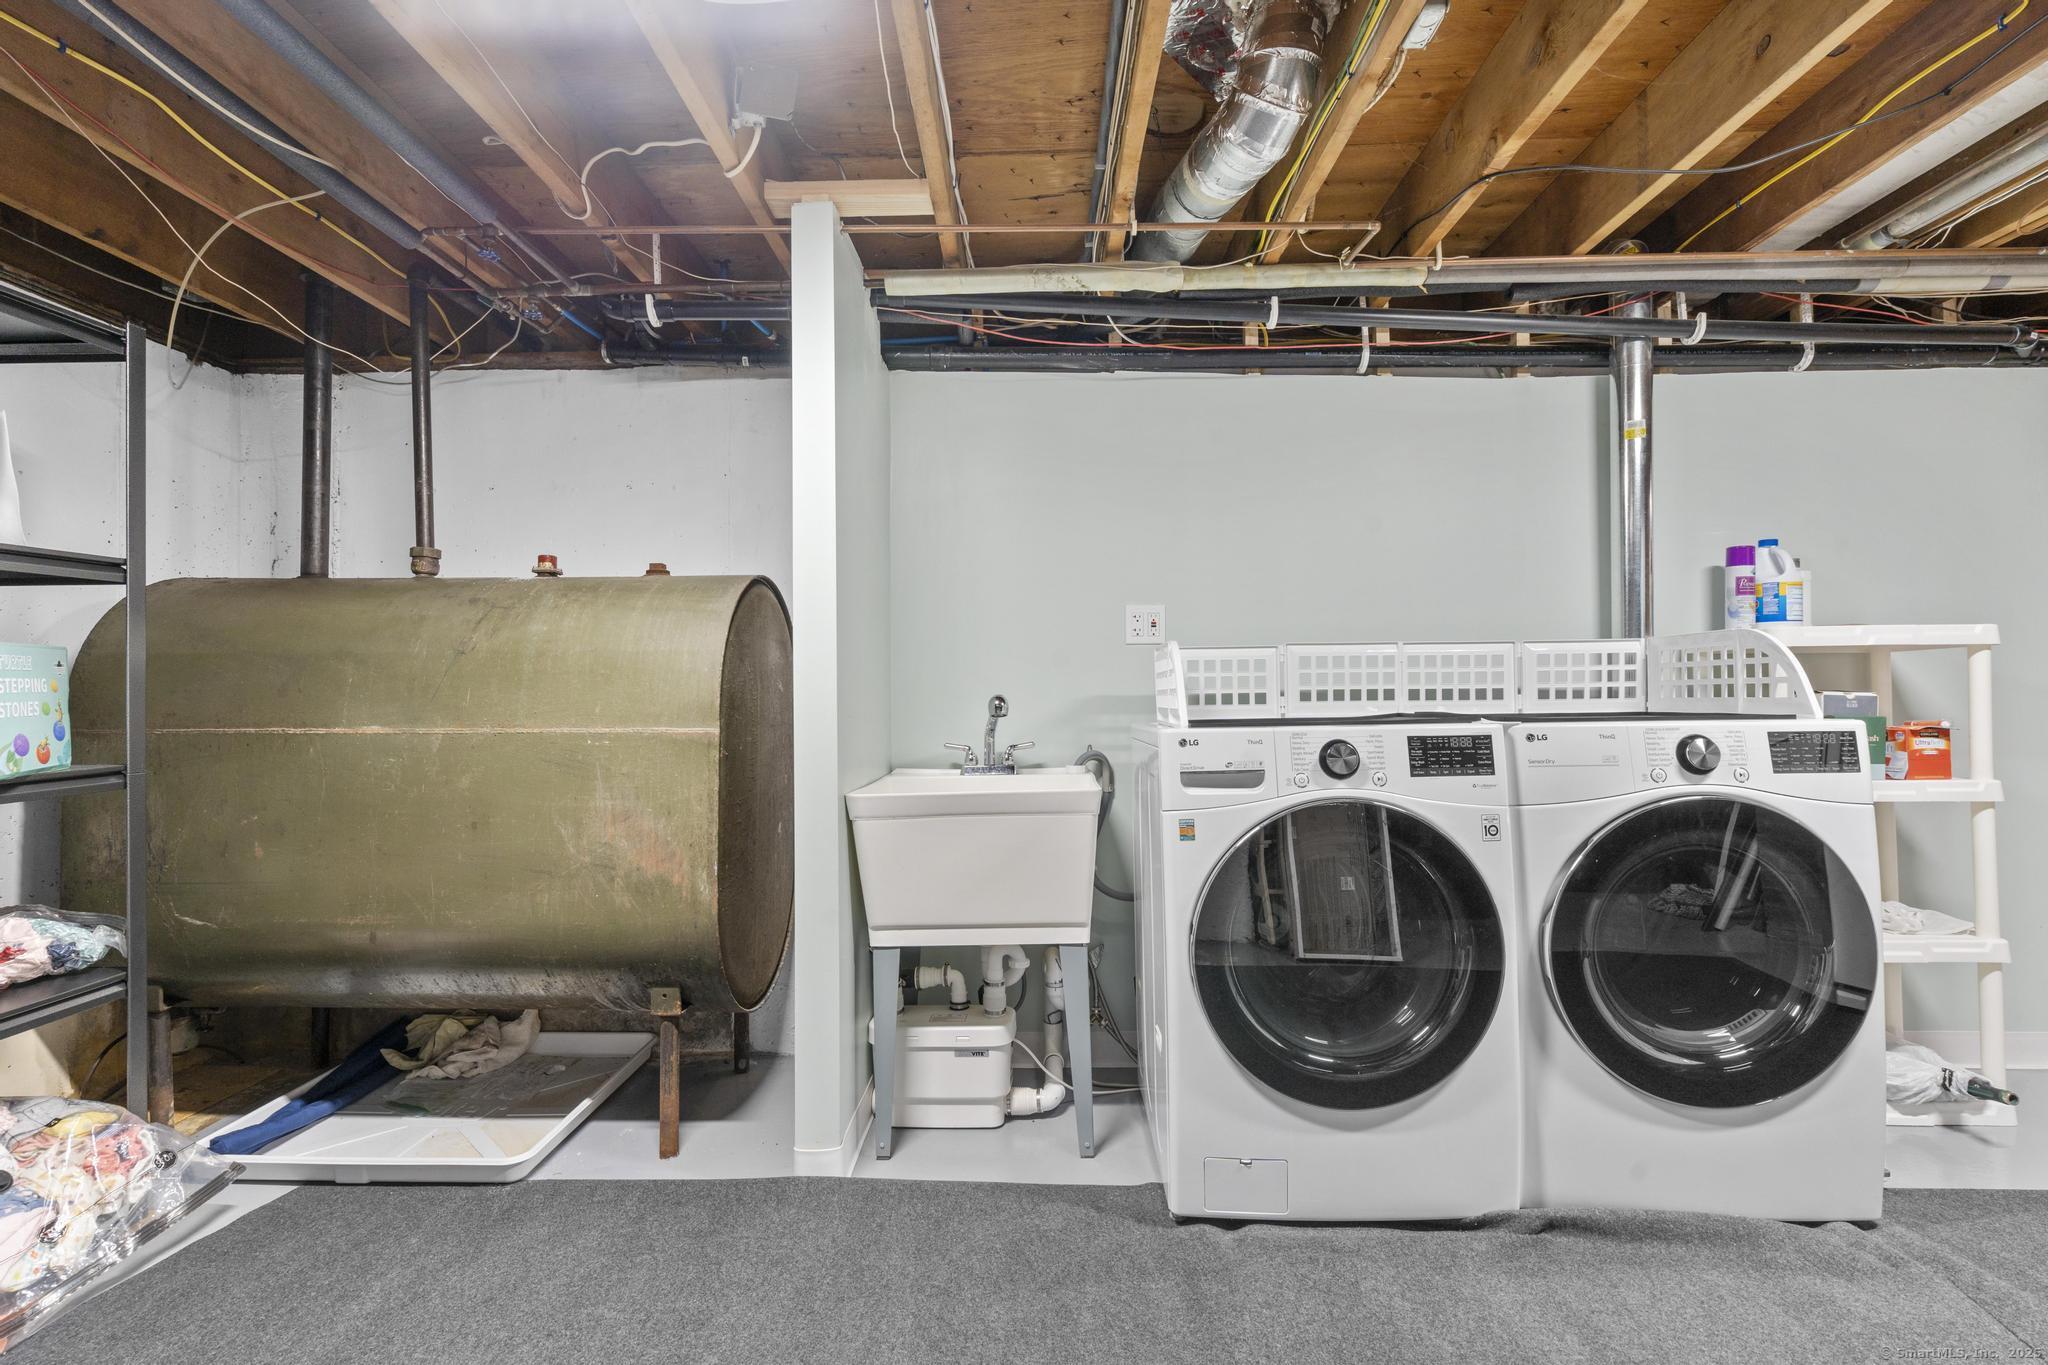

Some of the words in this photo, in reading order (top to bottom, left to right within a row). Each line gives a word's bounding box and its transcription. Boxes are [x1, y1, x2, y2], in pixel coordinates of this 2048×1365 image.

[0, 678, 48, 694] STEPPING
[0, 702, 40, 718] STONES
[1484, 824, 1499, 837] 10
